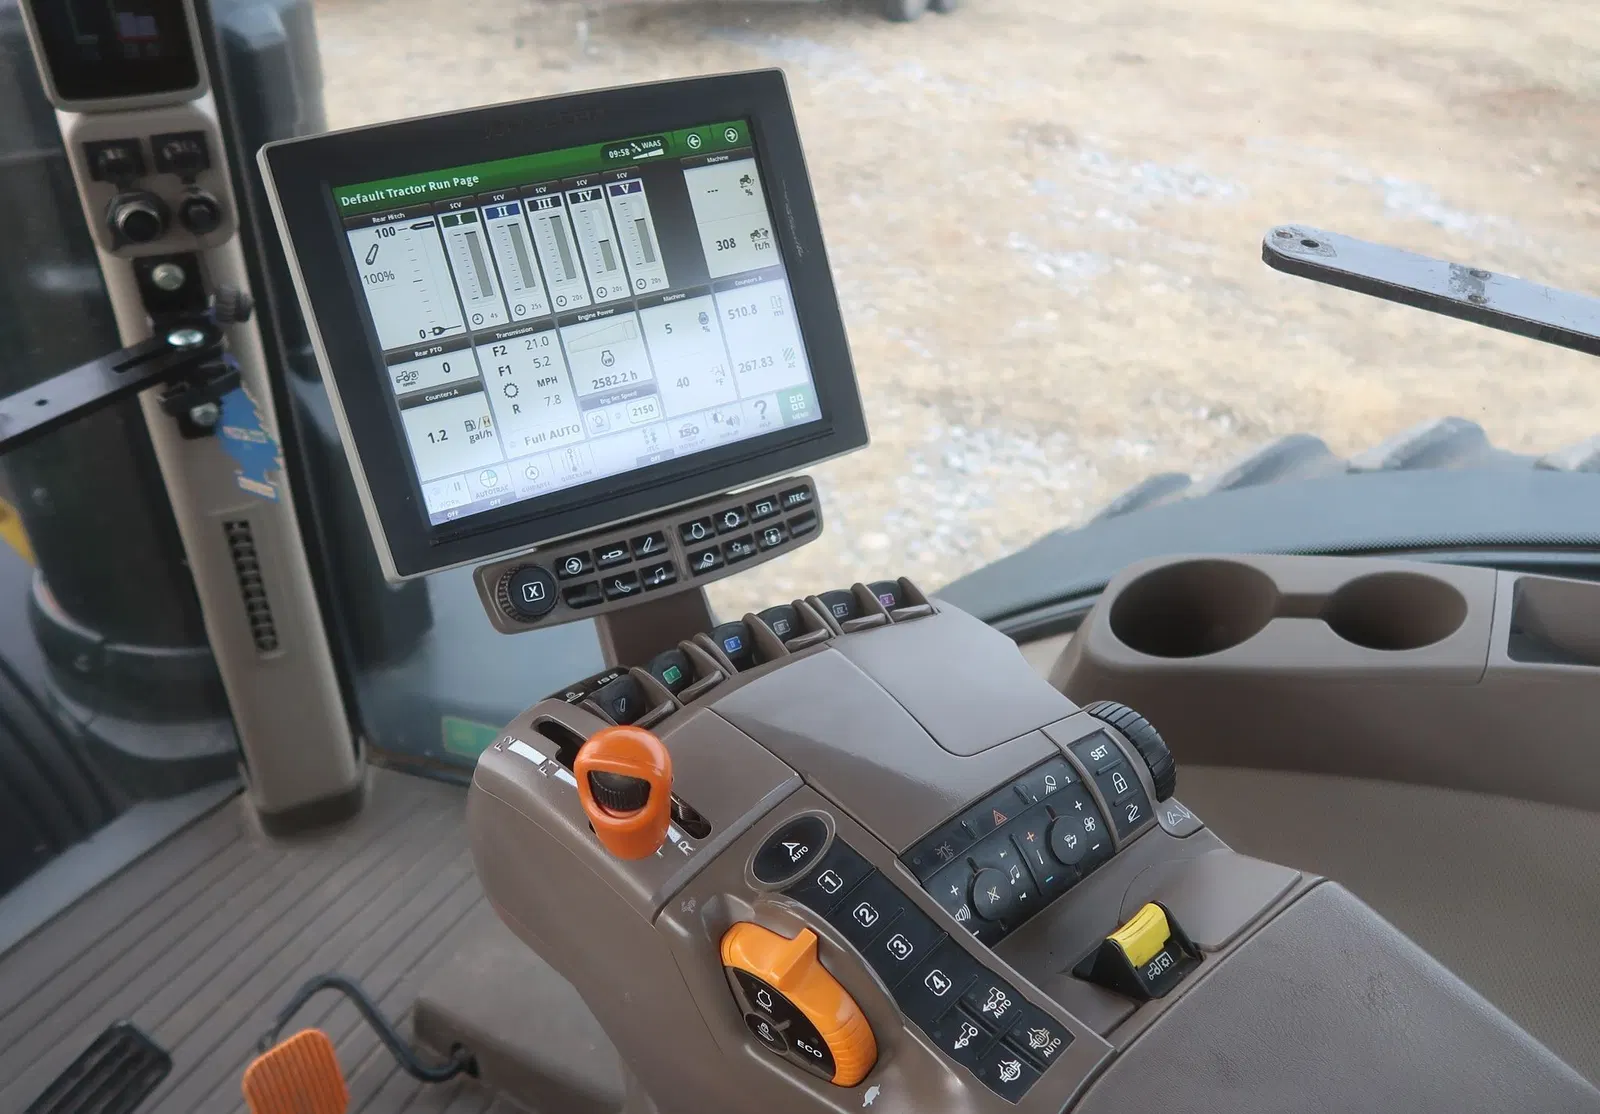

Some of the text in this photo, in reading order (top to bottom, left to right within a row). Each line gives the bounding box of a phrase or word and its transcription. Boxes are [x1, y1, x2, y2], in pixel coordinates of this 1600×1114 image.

[608, 139, 662, 159] 09:58 WAAS
[706, 154, 729, 163] Machine
[576, 178, 588, 186] SCV
[616, 172, 628, 180] SCV
[341, 174, 480, 207] Default Tractor Run Page
[535, 186, 547, 194] SCV
[619, 183, 630, 194] V
[578, 190, 593, 202] IV
[449, 202, 462, 210] SCV
[536, 198, 554, 210] III
[372, 212, 406, 224] Rear Hitch
[497, 206, 509, 218] II
[456, 214, 464, 225] I
[374, 226, 396, 240] 100
[716, 238, 736, 252] 308
[754, 241, 770, 251] ft/h
[363, 270, 396, 286] 100%
[572, 294, 583, 302] 20s
[663, 292, 686, 302] Machine
[531, 302, 543, 310] 25s
[728, 304, 758, 320] 510.8
[577, 308, 614, 321] Engine Power
[419, 329, 426, 339] 0
[496, 326, 534, 339] Transmission
[664, 323, 673, 335] 5
[414, 346, 443, 358] Rear PTO
[492, 336, 550, 358] F2 21.0
[442, 361, 452, 374] 0
[498, 356, 552, 378] F1 5.2
[738, 356, 774, 374] 267.83
[536, 376, 558, 388] MPH
[592, 370, 638, 390] 2582.2 h
[676, 376, 690, 389] 40
[424, 390, 452, 402] Counters
[512, 394, 562, 415] R 7.8
[632, 404, 654, 417] 2150
[427, 429, 449, 444] 1.2
[469, 430, 493, 445] gal/h
[524, 424, 580, 446] Full AUTO
[678, 425, 700, 439] ISO
[446, 510, 460, 518] OFF
[528, 586, 540, 598] X
[1090, 744, 1109, 762] SET
[677, 840, 696, 857] R
[791, 845, 809, 862] AUTO
[824, 875, 836, 887] 1
[860, 908, 874, 923] 2
[894, 940, 907, 954] 3
[932, 976, 946, 990] 4
[993, 998, 1012, 1019] AUTO
[796, 1039, 823, 1058] ECO
[1042, 1037, 1062, 1058] AUTO
